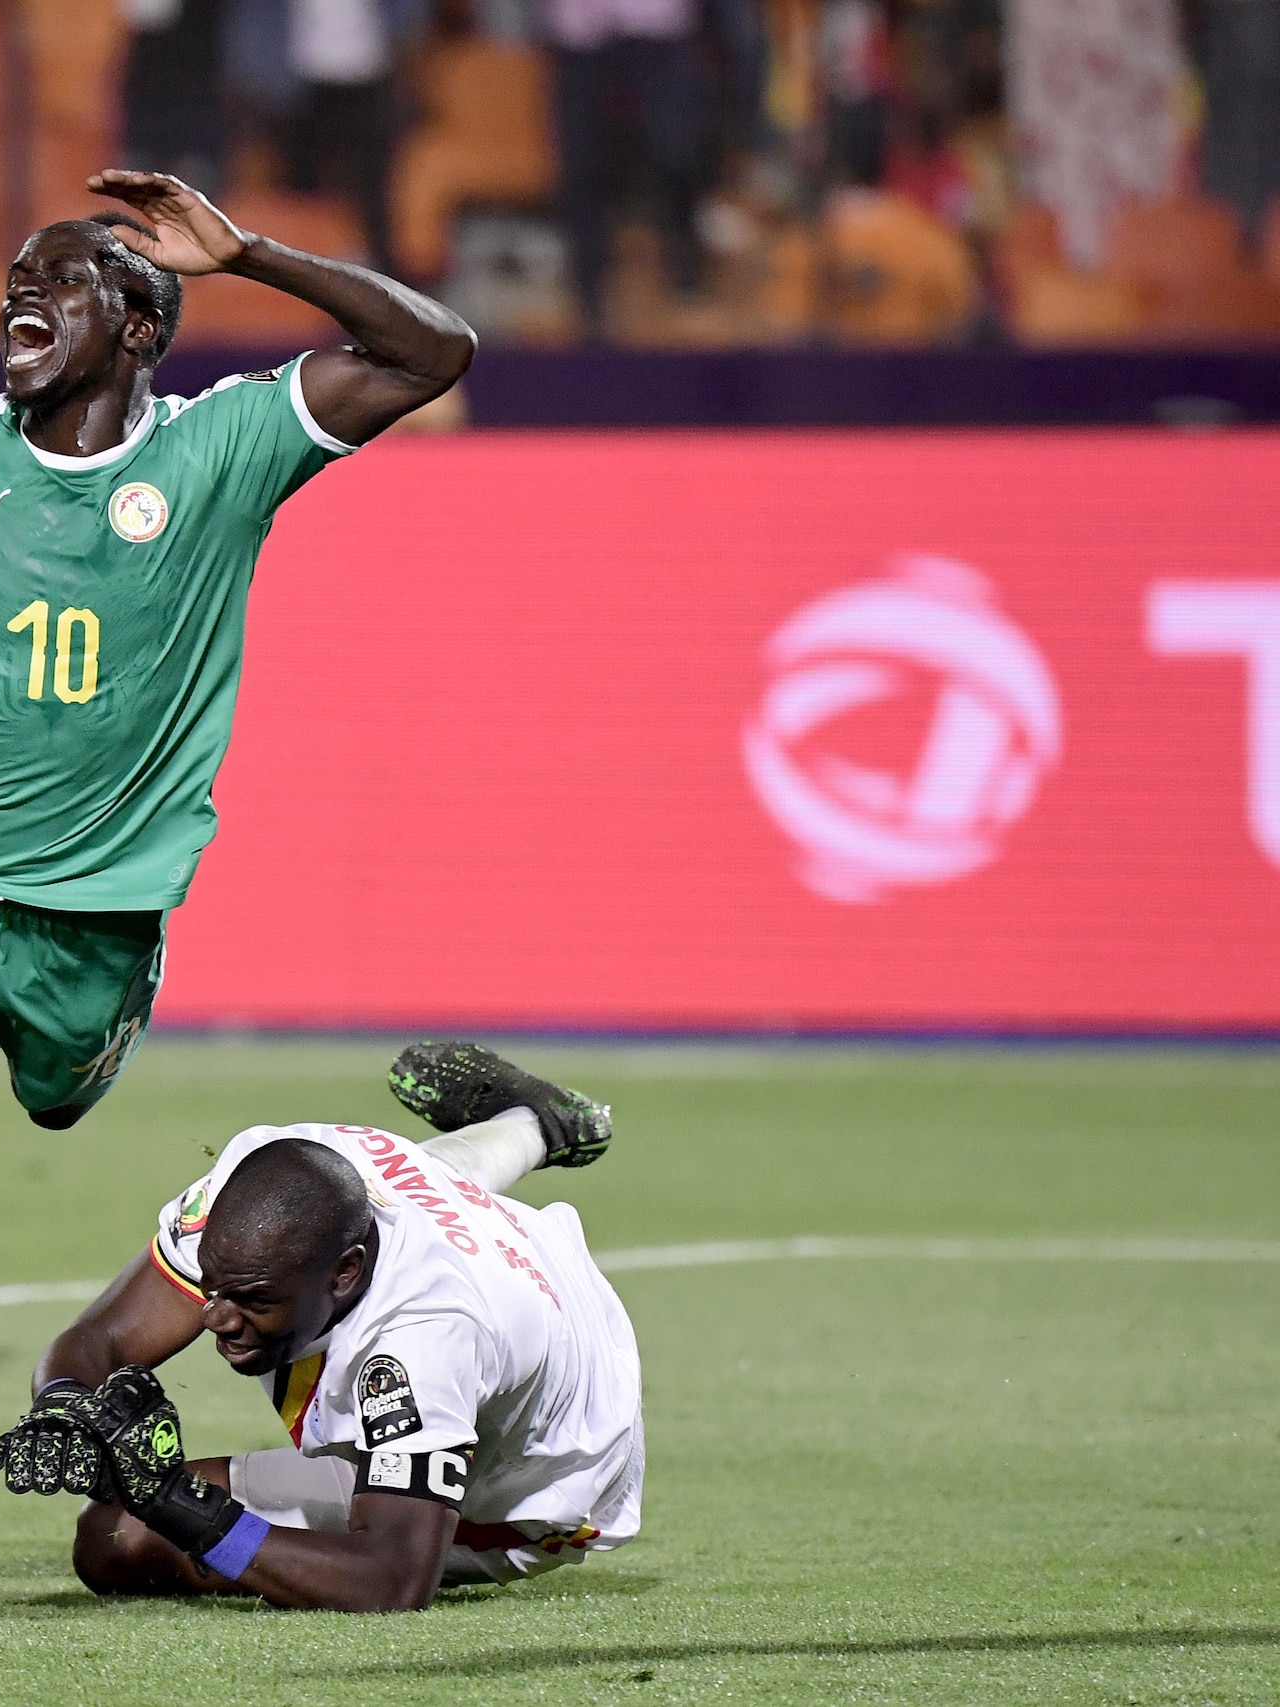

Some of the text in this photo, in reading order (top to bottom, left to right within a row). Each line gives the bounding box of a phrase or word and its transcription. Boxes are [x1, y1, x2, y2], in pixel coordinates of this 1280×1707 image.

[7, 600, 100, 704] 10
[335, 1125, 480, 1256] ONYANGO
[363, 1386, 411, 1417] Celebrate
[372, 1417, 412, 1440] CAF
[427, 1450, 468, 1501] C
